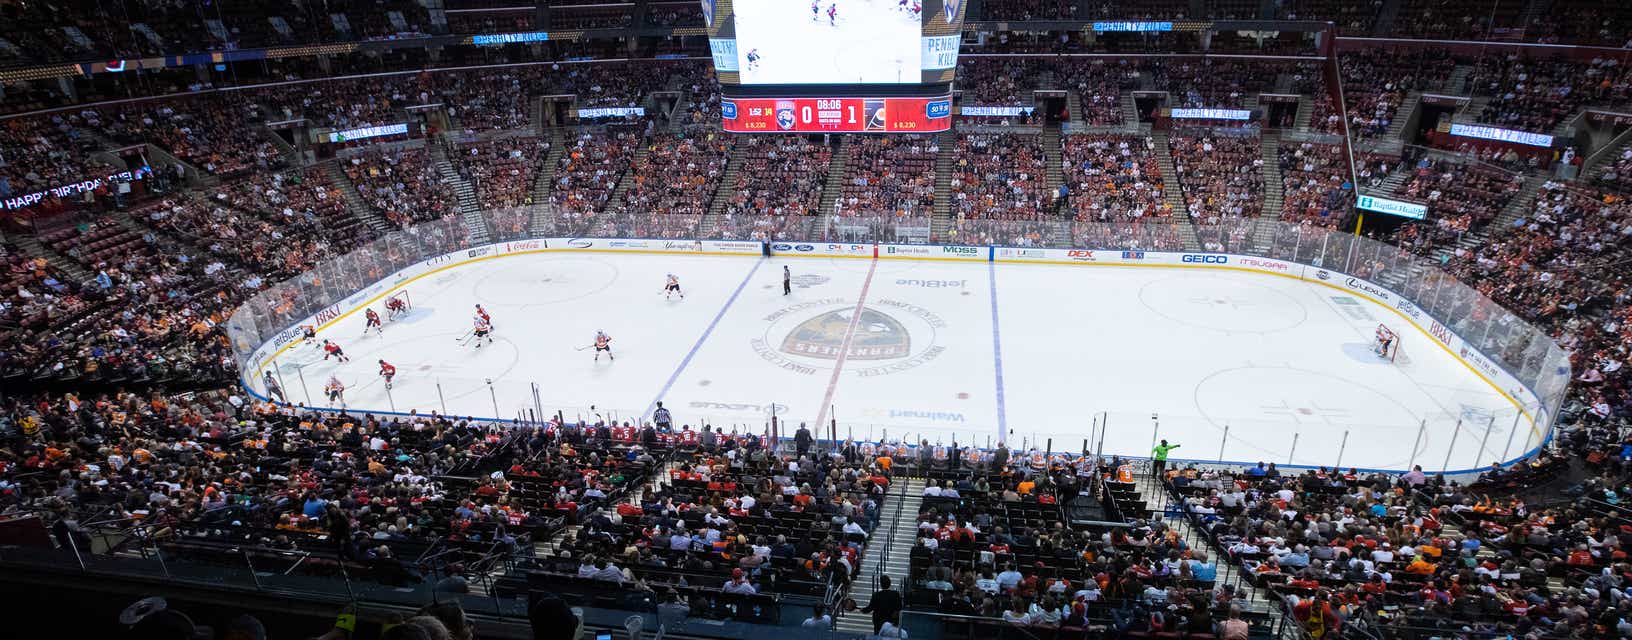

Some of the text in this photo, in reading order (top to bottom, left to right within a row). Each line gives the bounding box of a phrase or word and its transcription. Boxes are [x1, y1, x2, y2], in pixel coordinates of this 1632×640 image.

[802, 106, 812, 124] 0
[847, 106, 857, 124] 1
[1067, 250, 1093, 258] DEX
[1182, 254, 1227, 264] GEICO
[314, 303, 342, 326] BB&T
[273, 326, 300, 350] jetBlue
[796, 343, 896, 356] PANTHERS
